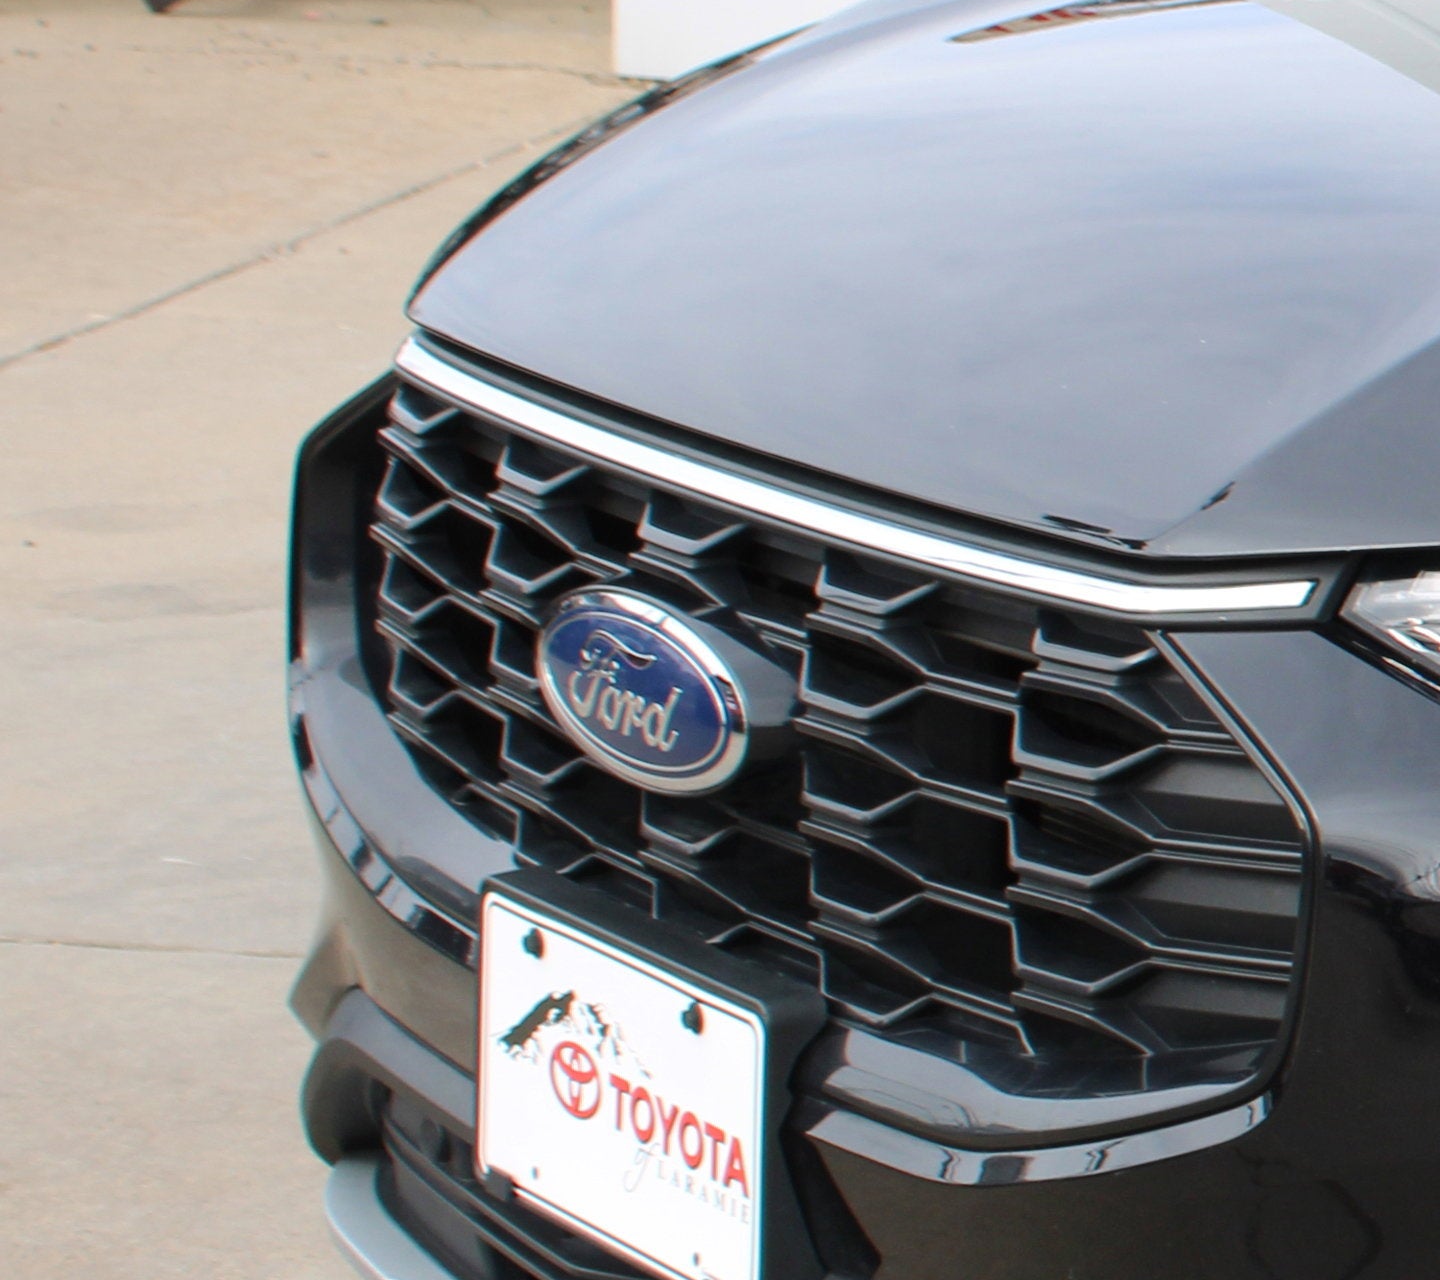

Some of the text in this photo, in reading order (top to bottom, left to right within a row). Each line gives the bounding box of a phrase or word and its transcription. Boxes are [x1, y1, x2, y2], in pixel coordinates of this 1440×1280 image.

[568, 628, 683, 752] Ford
[610, 1074, 750, 1199] TOYOTA
[656, 1159, 751, 1225] LARAMIE
